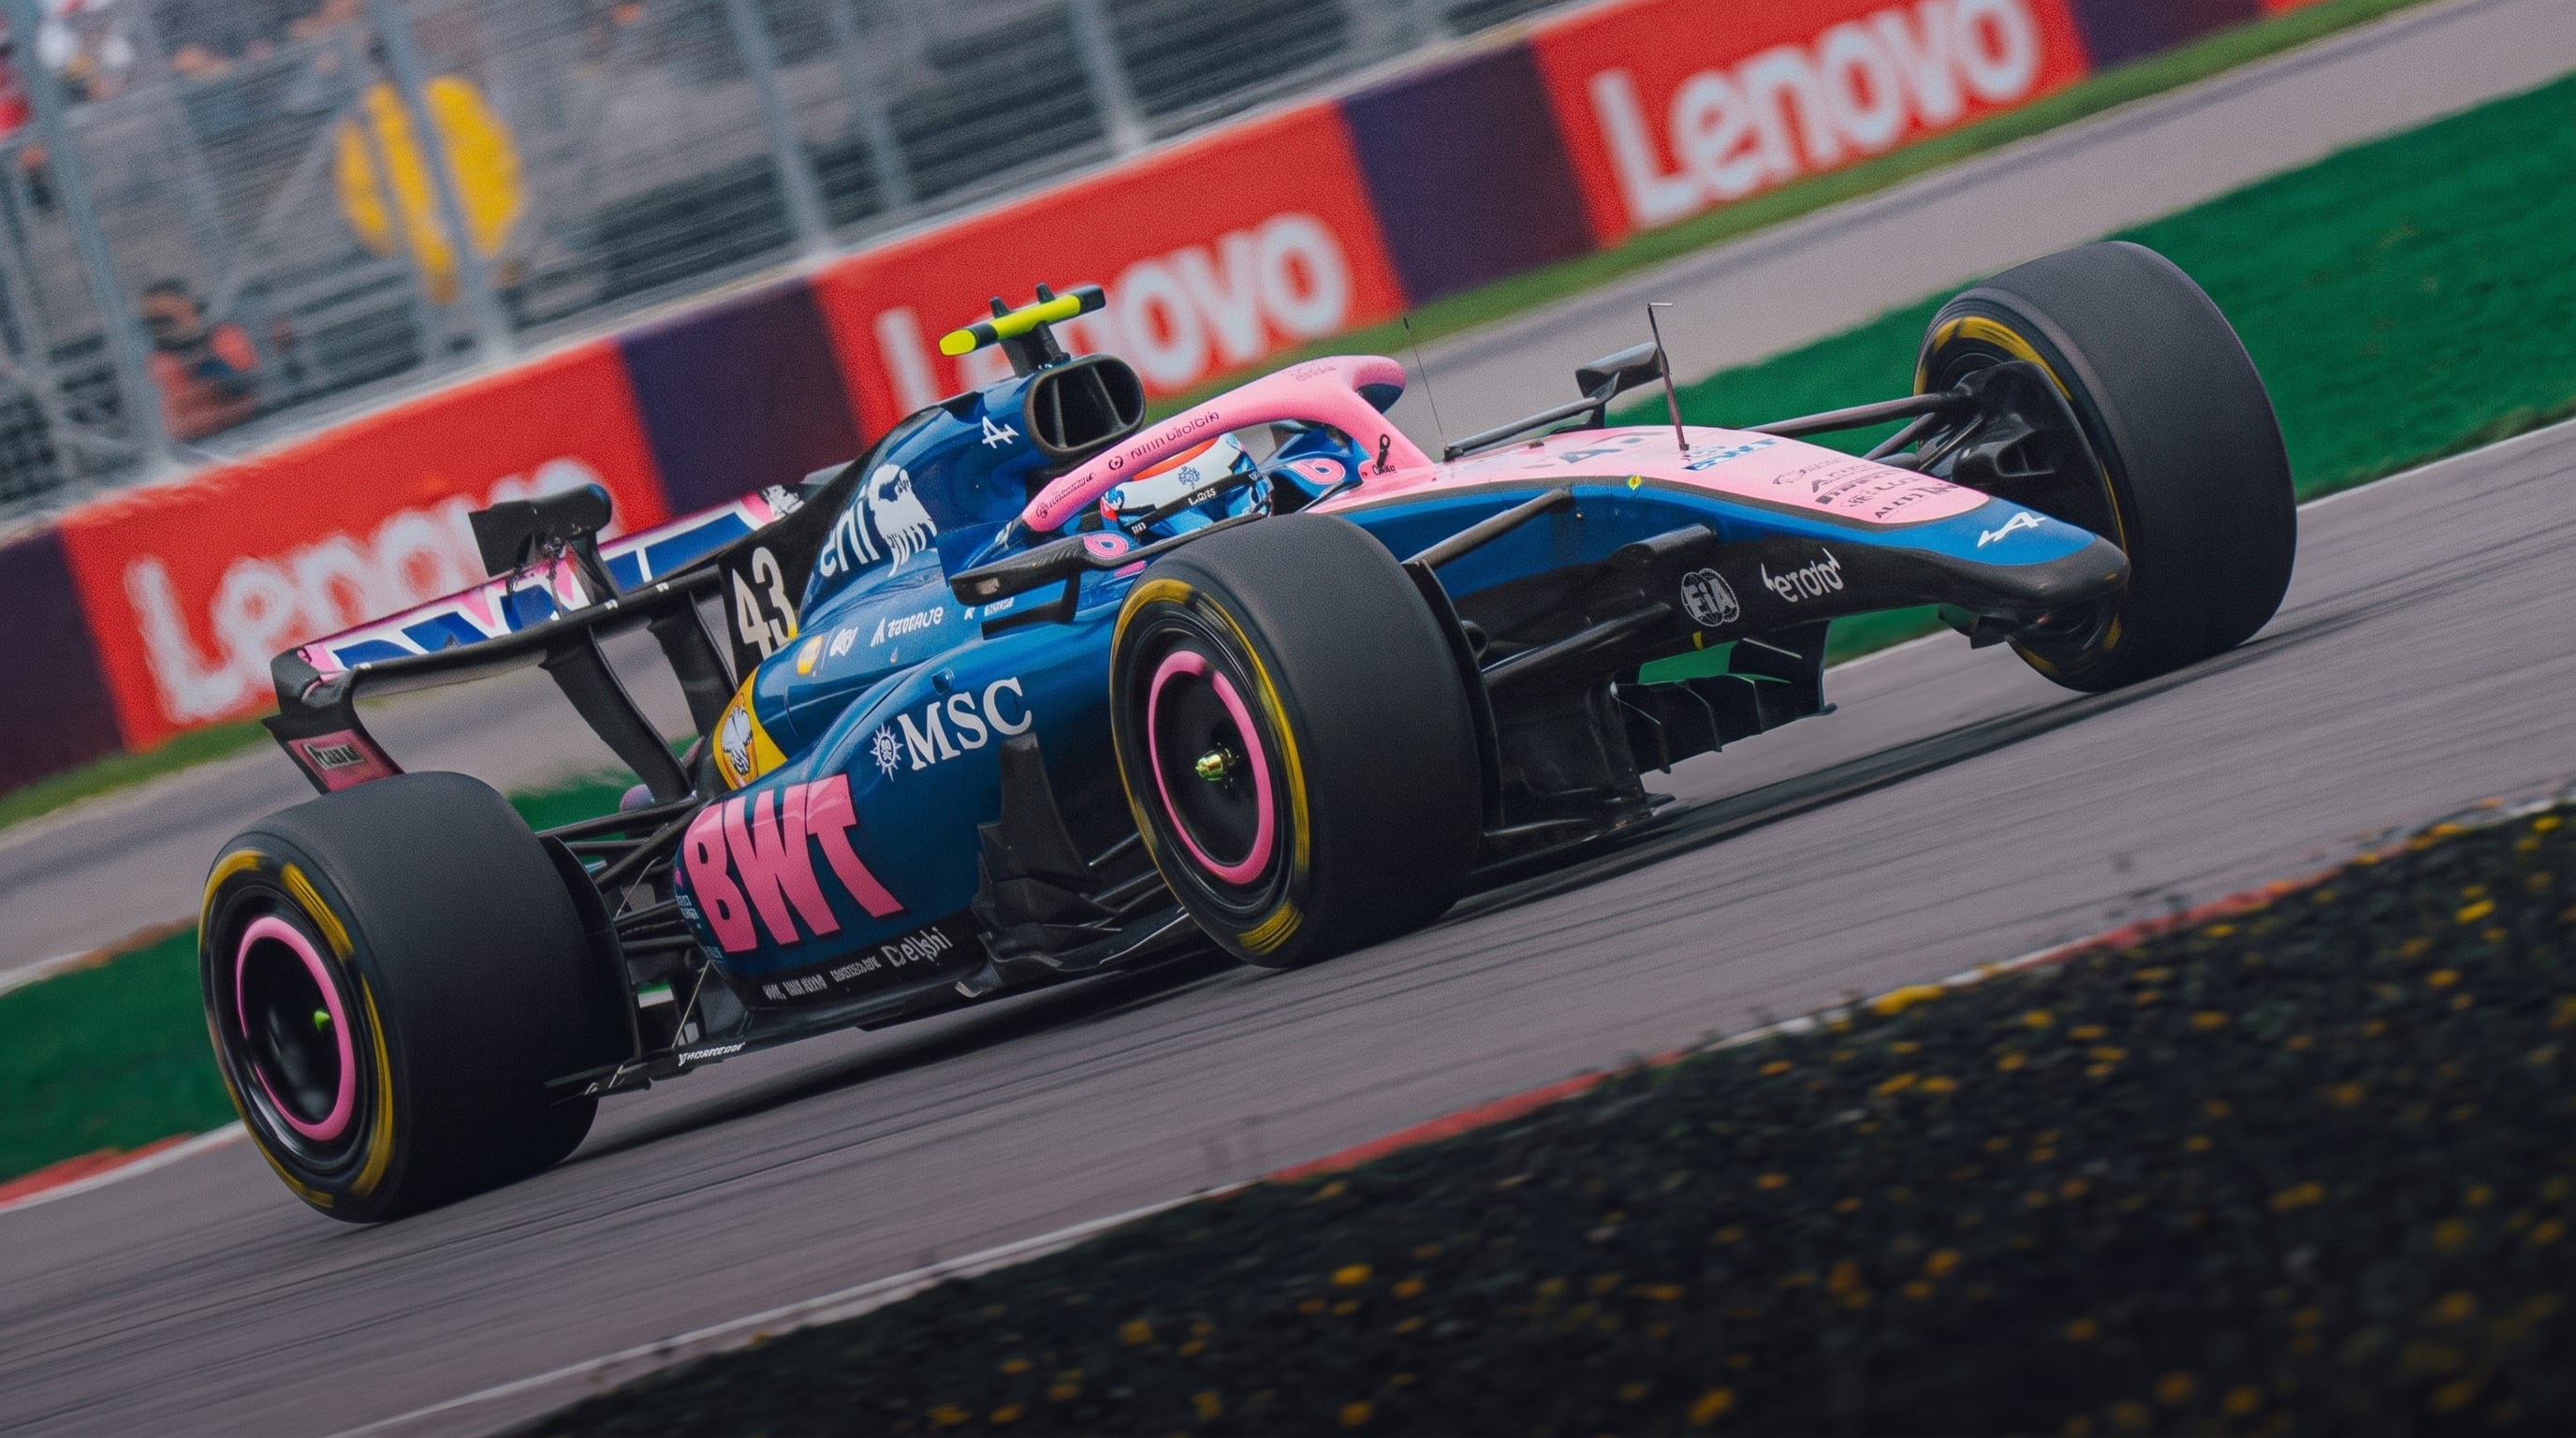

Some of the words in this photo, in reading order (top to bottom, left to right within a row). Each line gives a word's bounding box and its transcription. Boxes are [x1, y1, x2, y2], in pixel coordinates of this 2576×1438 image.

[1589, 0, 2044, 225] Lenovo
[732, 547, 798, 658] 43
[898, 676, 1032, 771] MSC
[683, 773, 904, 953] BWT
